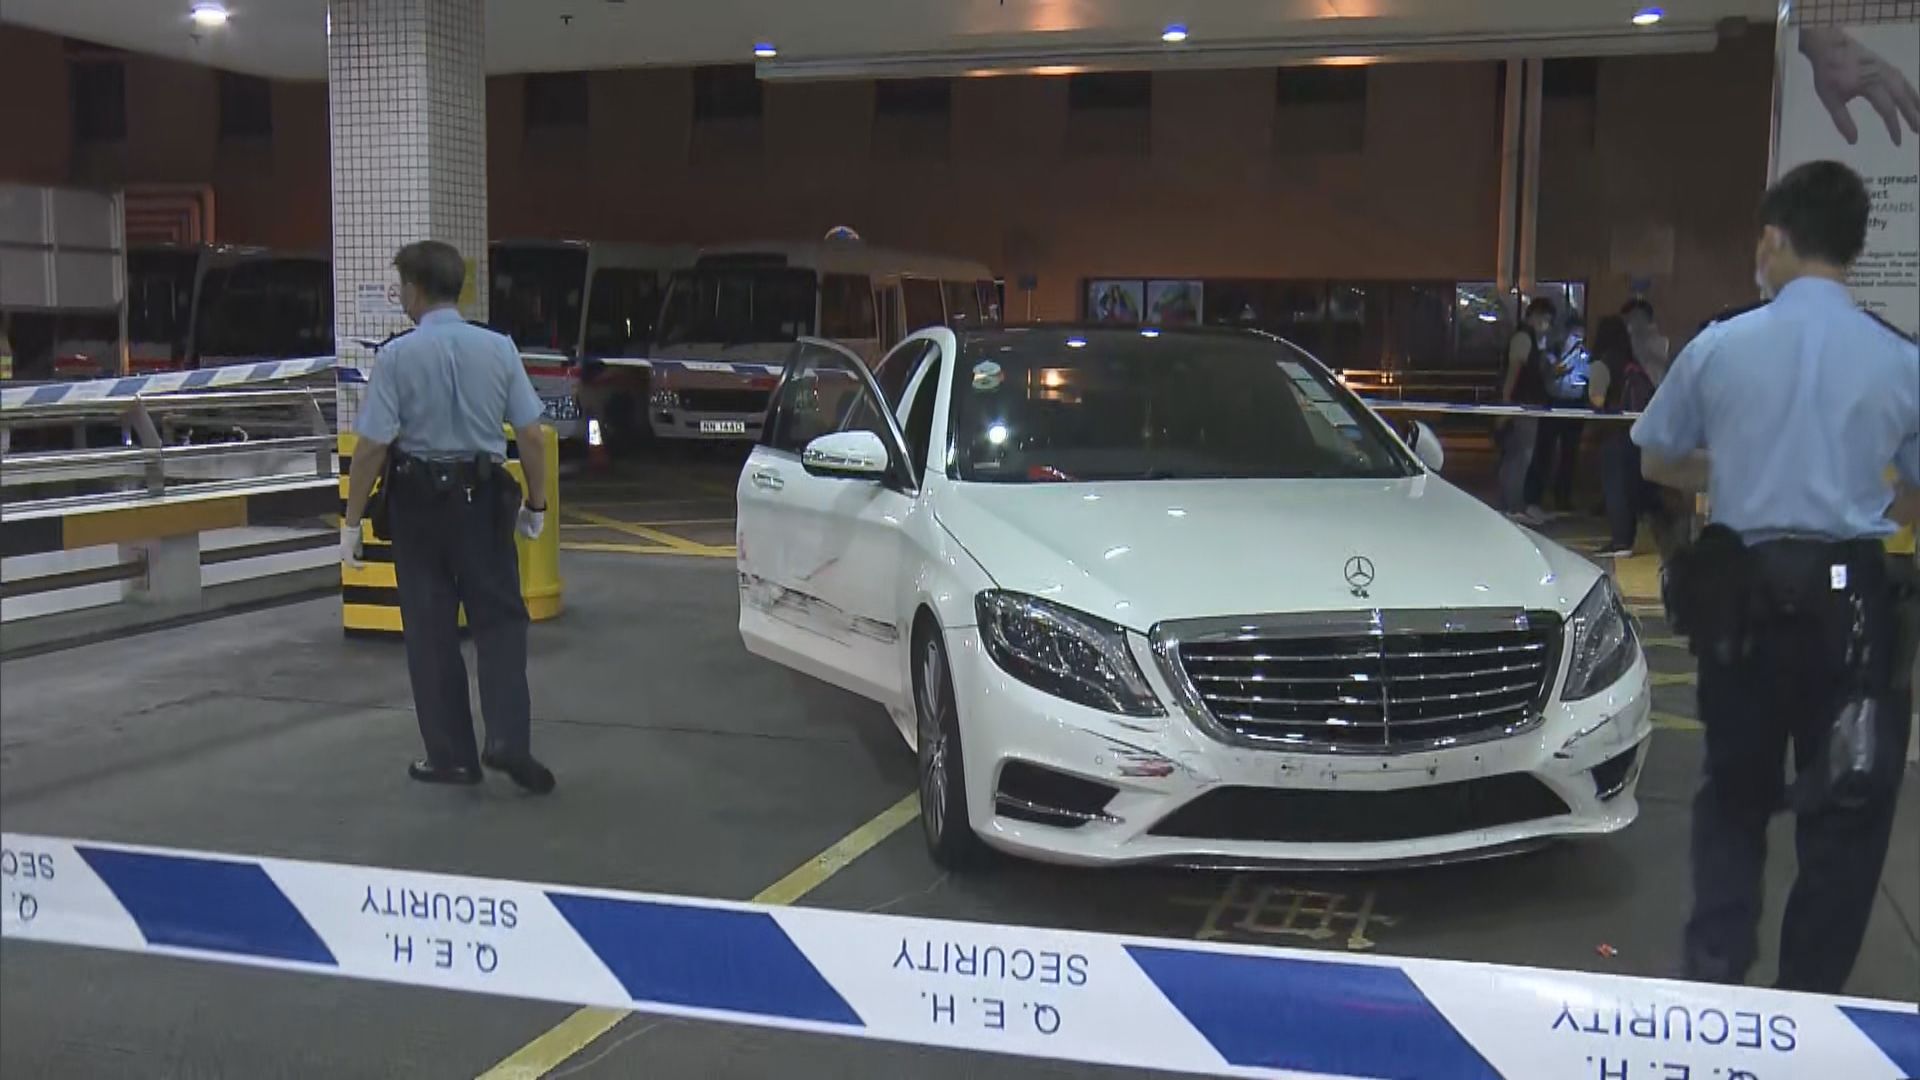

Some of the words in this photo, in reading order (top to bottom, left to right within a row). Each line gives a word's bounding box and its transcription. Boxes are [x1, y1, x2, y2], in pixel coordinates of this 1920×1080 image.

[1877, 175, 1917, 187] spread
[361, 885, 518, 929] SECURITY
[893, 938, 1089, 986] SECURITY
[1551, 1000, 1797, 1051] SECURITY
